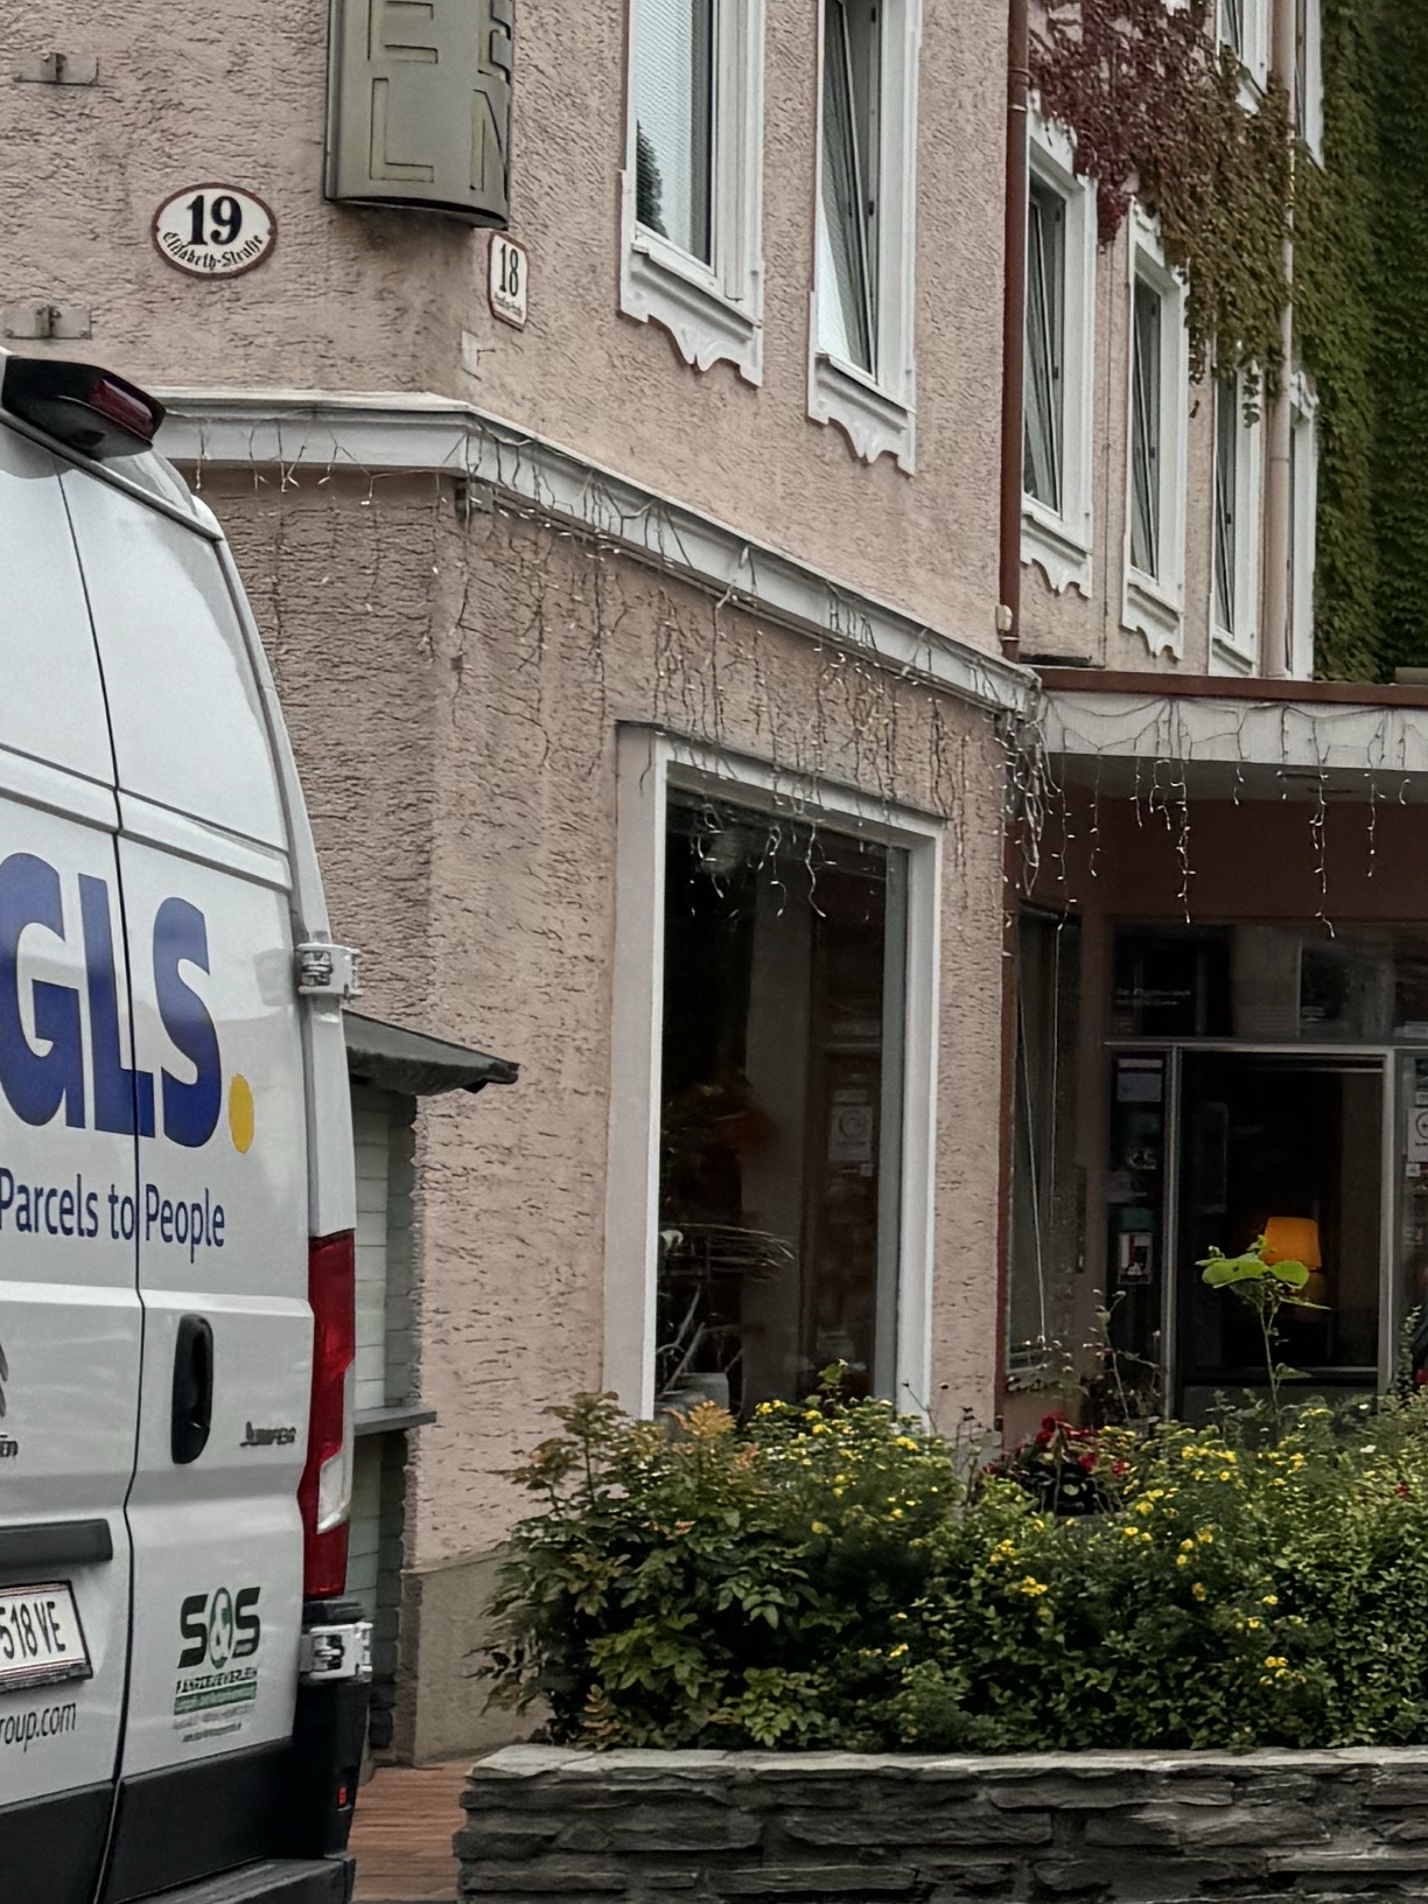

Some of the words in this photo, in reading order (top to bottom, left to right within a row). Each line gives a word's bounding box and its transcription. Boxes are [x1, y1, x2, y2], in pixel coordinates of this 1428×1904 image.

[186, 195, 243, 245] 19
[499, 243, 519, 297] 18
[0, 1167, 99, 1239] Parcels
[108, 1183, 136, 1242] to
[145, 1182, 226, 1264] People
